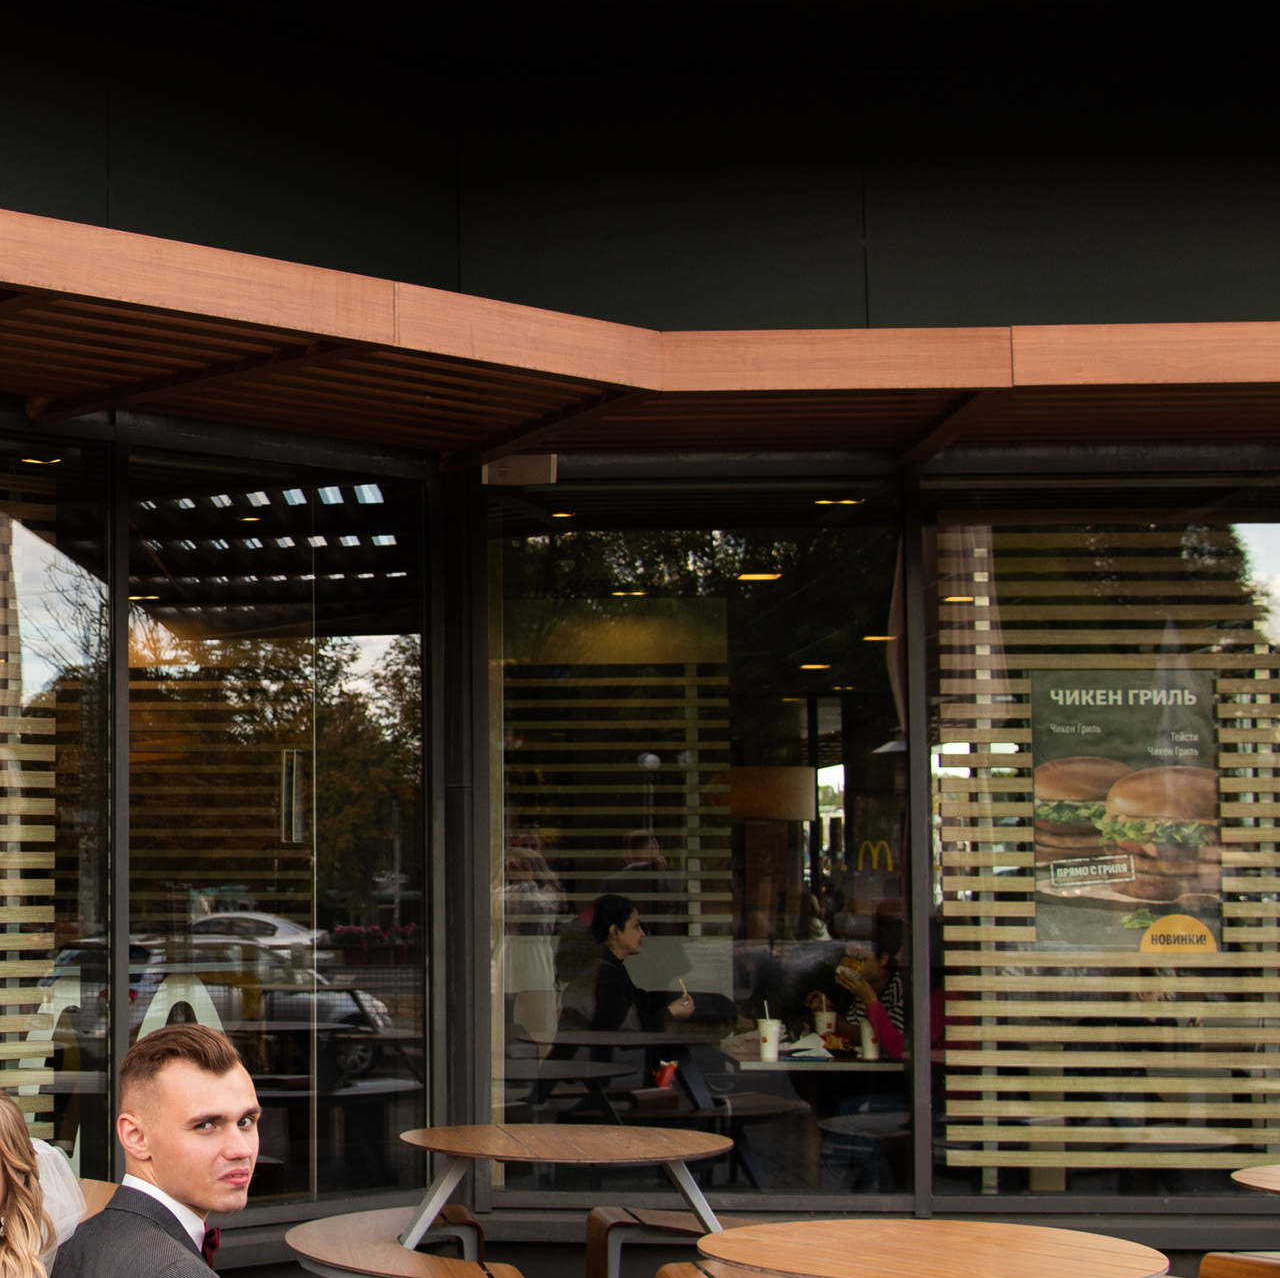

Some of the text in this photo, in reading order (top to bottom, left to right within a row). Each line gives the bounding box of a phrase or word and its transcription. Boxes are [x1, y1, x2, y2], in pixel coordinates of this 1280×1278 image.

[1049, 689, 1197, 706] ЧИКЕН ГРИЛЬ
[1050, 723, 1102, 735] Чикен Гриль
[1147, 746, 1199, 757] Чикен Гриль
[1056, 863, 1128, 878] ПРЯМО С ГРИЛЯ
[1151, 934, 1207, 945] НОВИНКИ!
